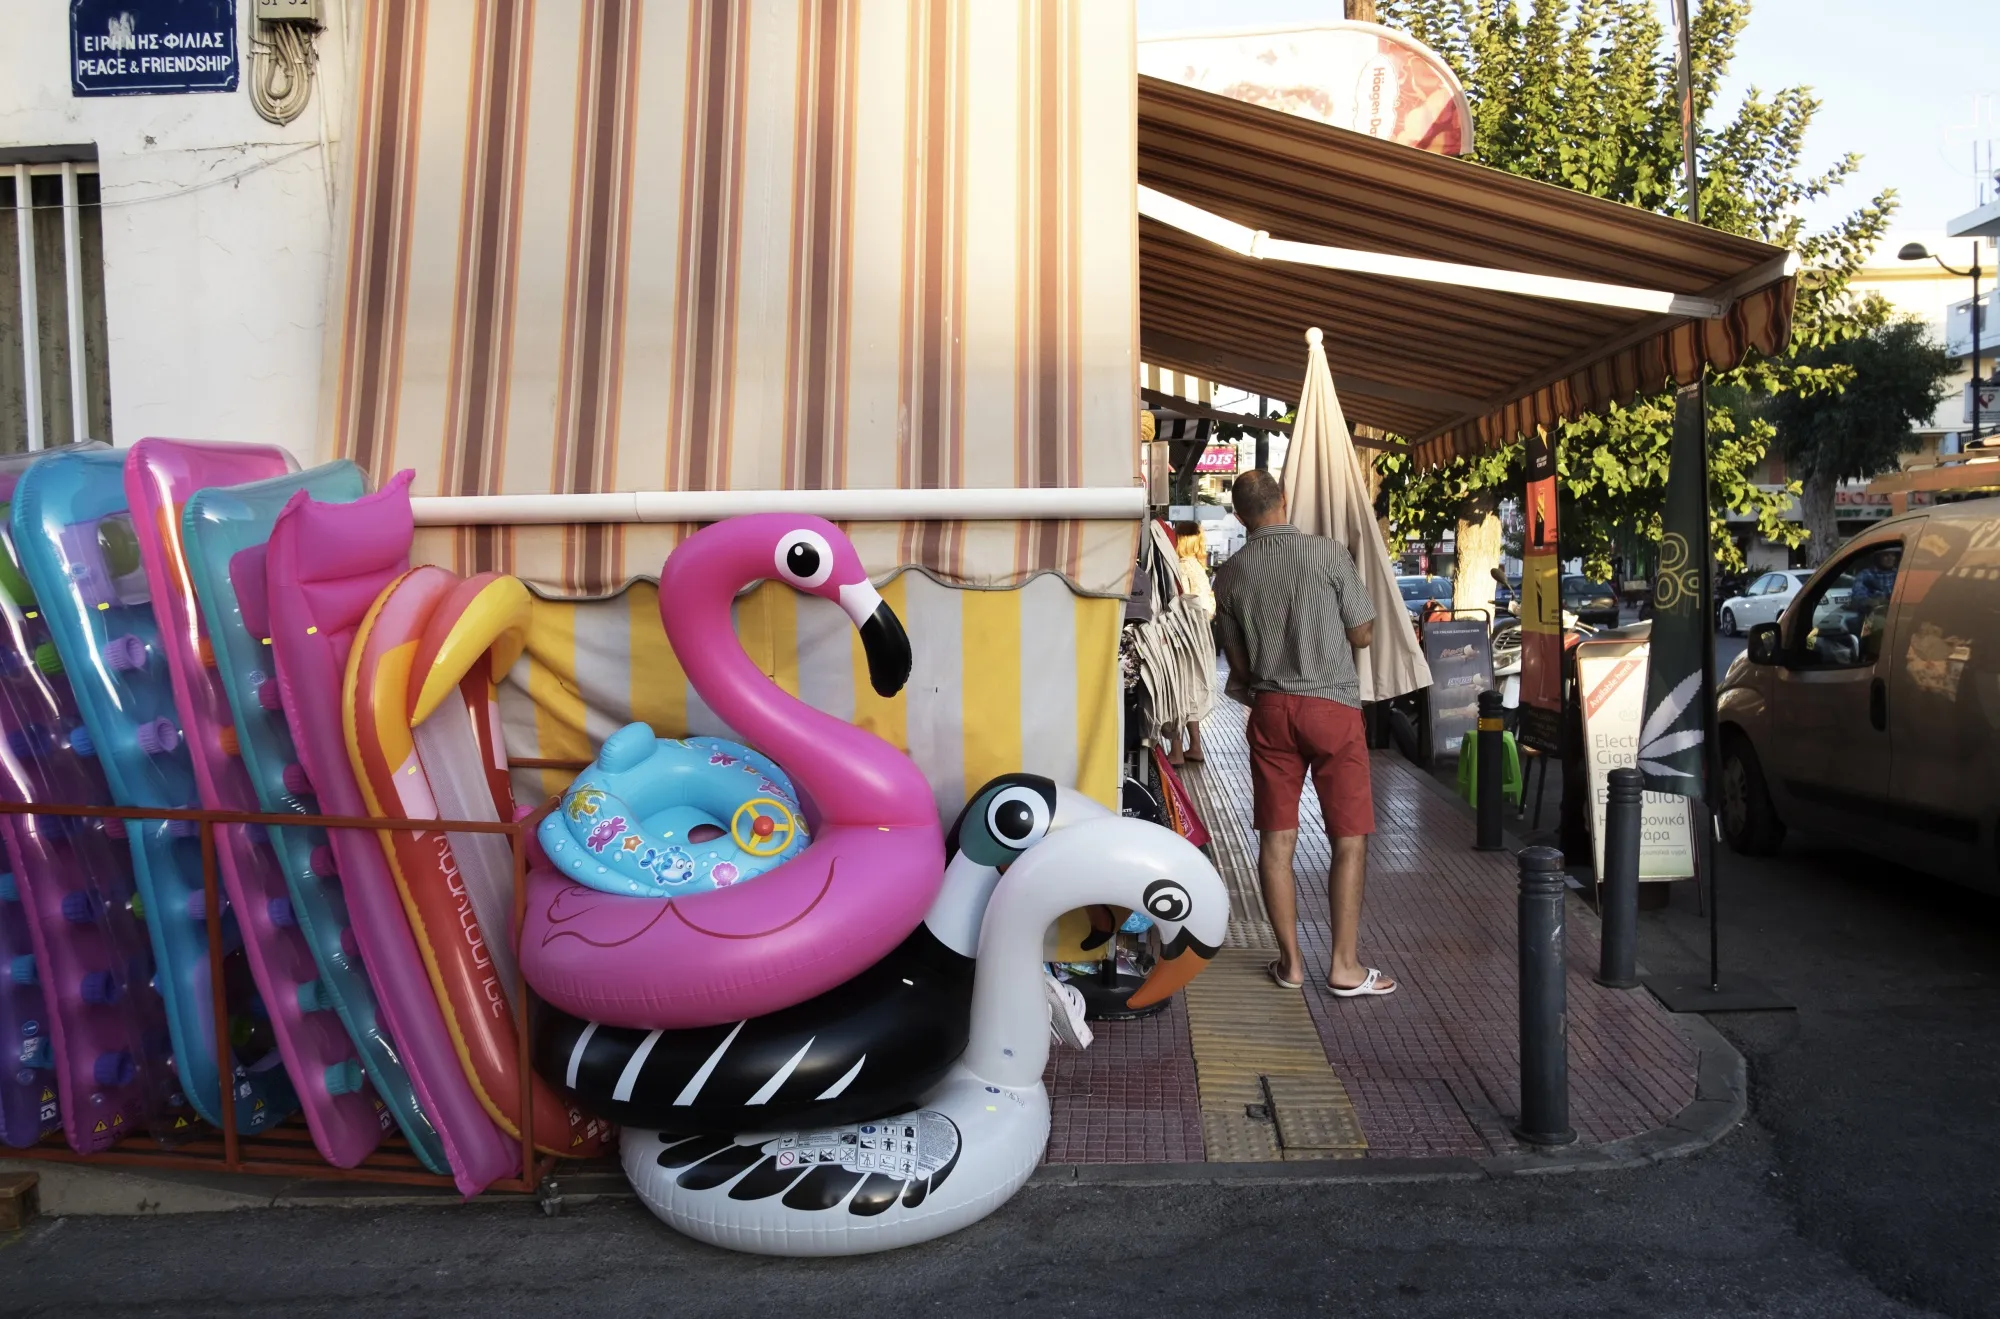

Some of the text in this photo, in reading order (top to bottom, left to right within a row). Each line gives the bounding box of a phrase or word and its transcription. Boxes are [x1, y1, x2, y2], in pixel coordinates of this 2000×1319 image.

[79, 55, 231, 76] PEACE & FRIENDSHIP
[1197, 454, 1233, 465] ADIS
[1589, 661, 1633, 708] Available here!
